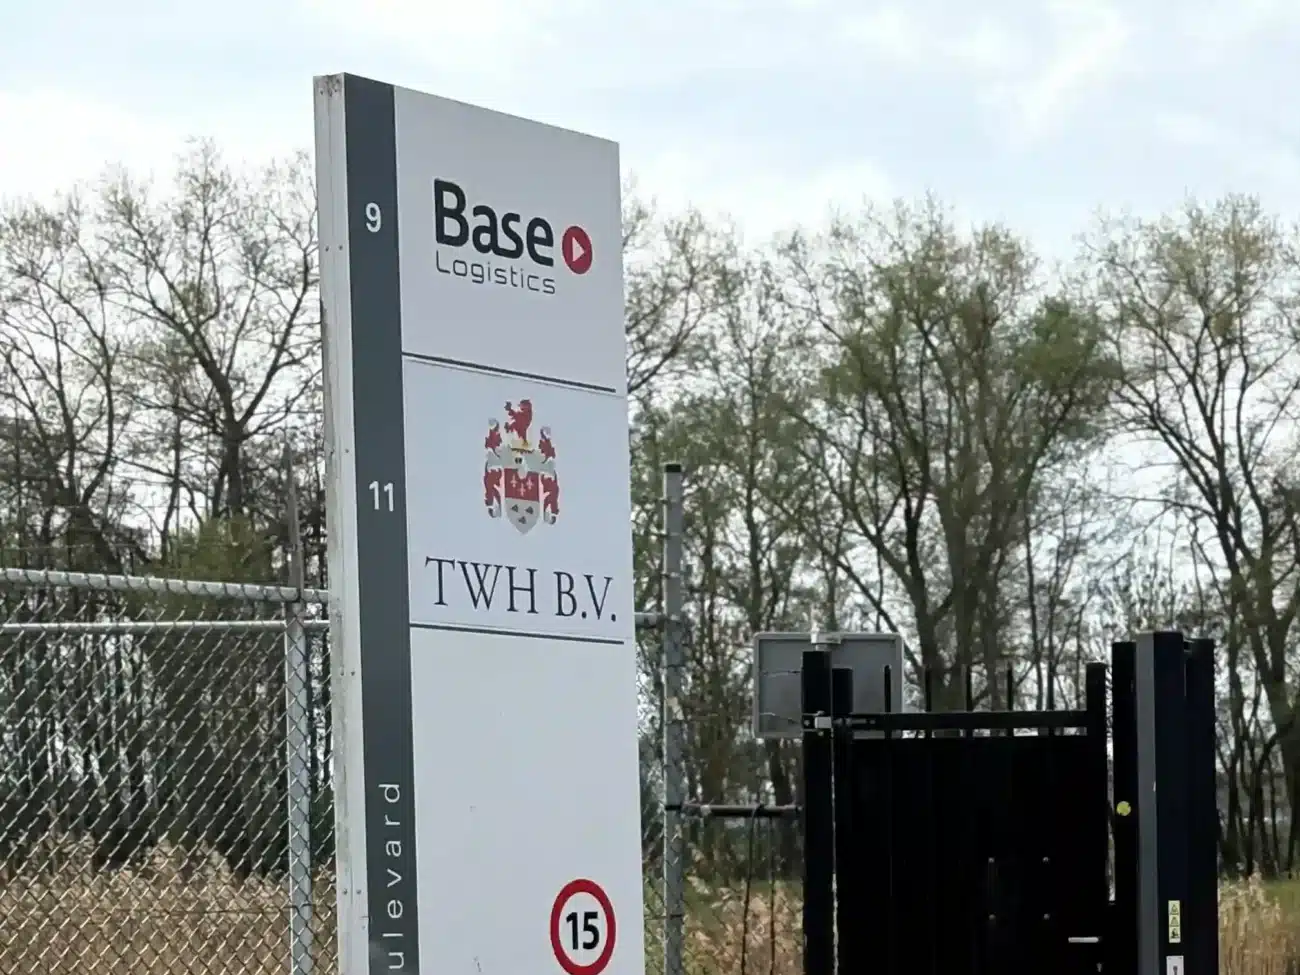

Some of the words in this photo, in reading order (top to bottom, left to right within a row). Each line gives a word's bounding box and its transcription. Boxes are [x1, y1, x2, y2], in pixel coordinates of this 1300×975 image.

[365, 203, 382, 233] 9
[434, 178, 554, 267] Base
[435, 250, 556, 295] Logistics
[369, 480, 395, 512] 11
[425, 556, 539, 614] TWH
[554, 571, 617, 622] B.V.
[565, 911, 600, 951] 15
